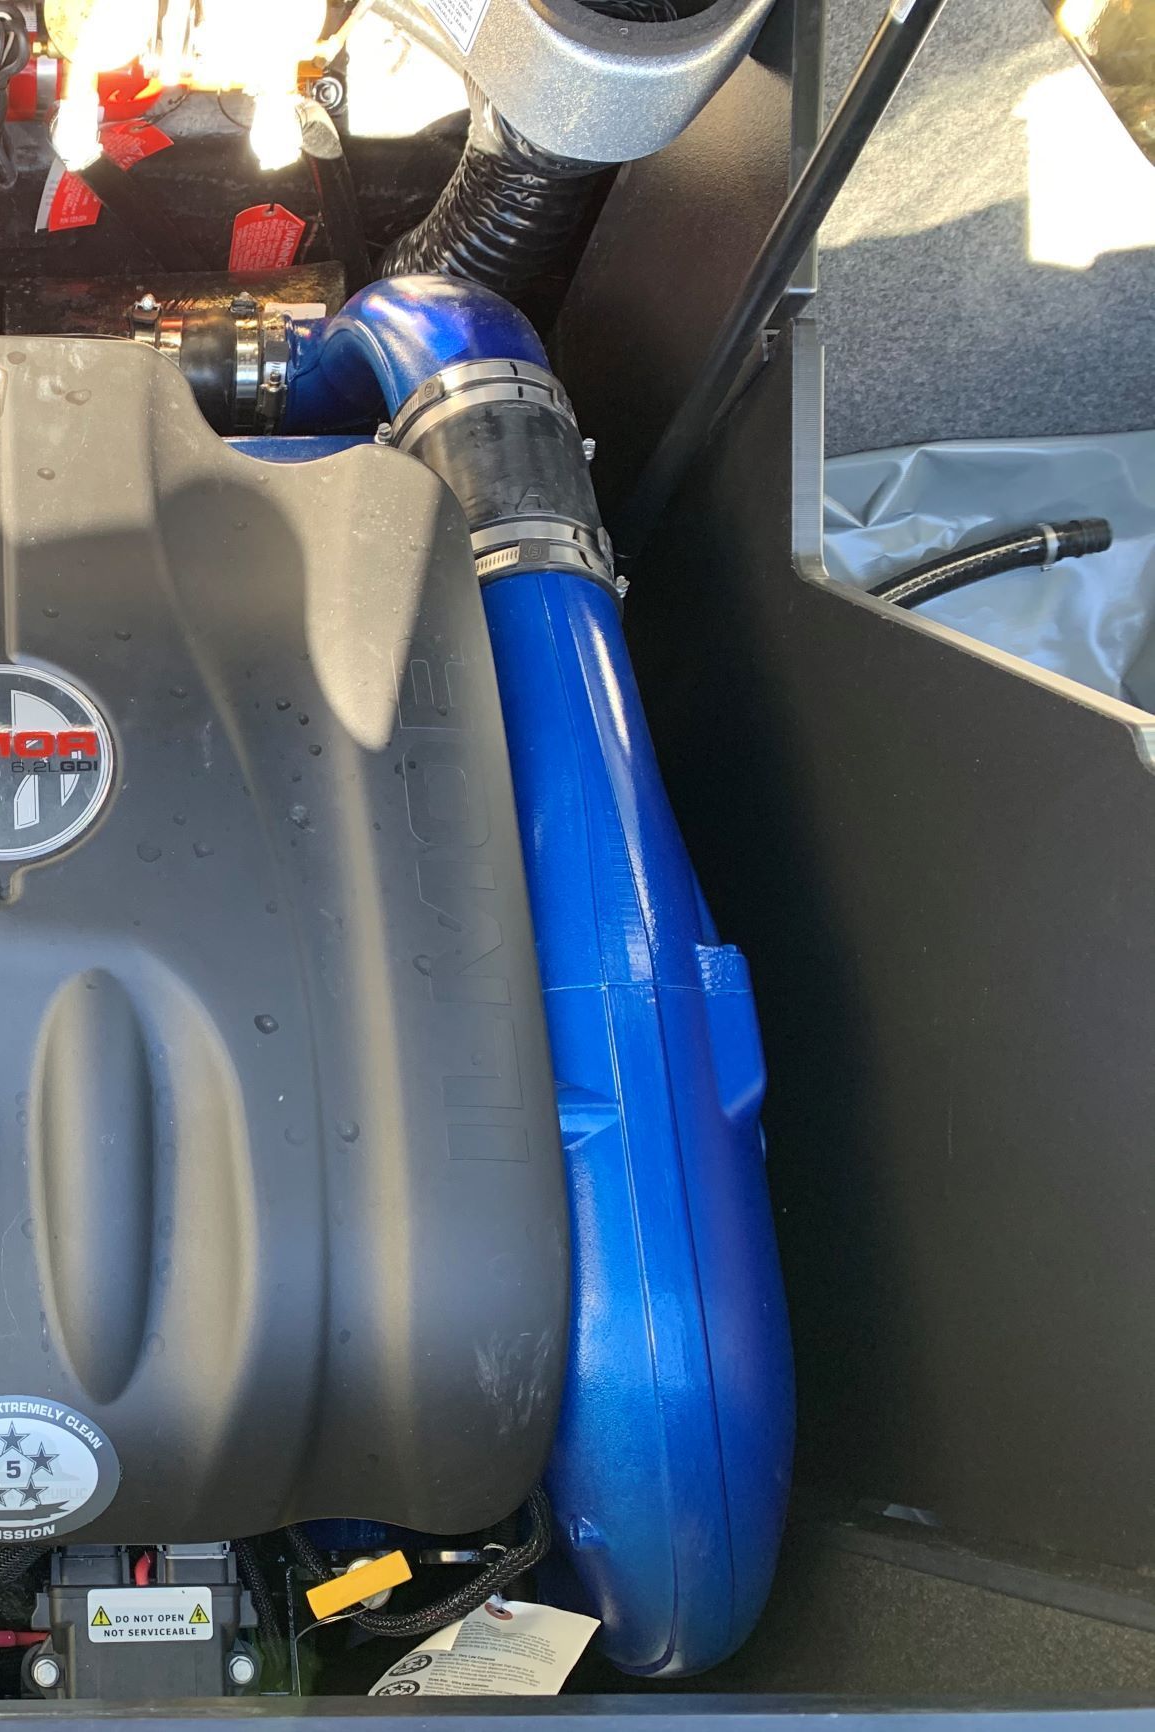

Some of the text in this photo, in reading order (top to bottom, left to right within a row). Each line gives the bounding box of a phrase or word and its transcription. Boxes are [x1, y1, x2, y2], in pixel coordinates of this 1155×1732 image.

[64, 1415, 104, 1450] CLEAN
[6, 1460, 22, 1479] 5
[115, 1614, 184, 1623] DO NOT OPEN
[103, 1627, 197, 1637] NOT SERVICEABLE
